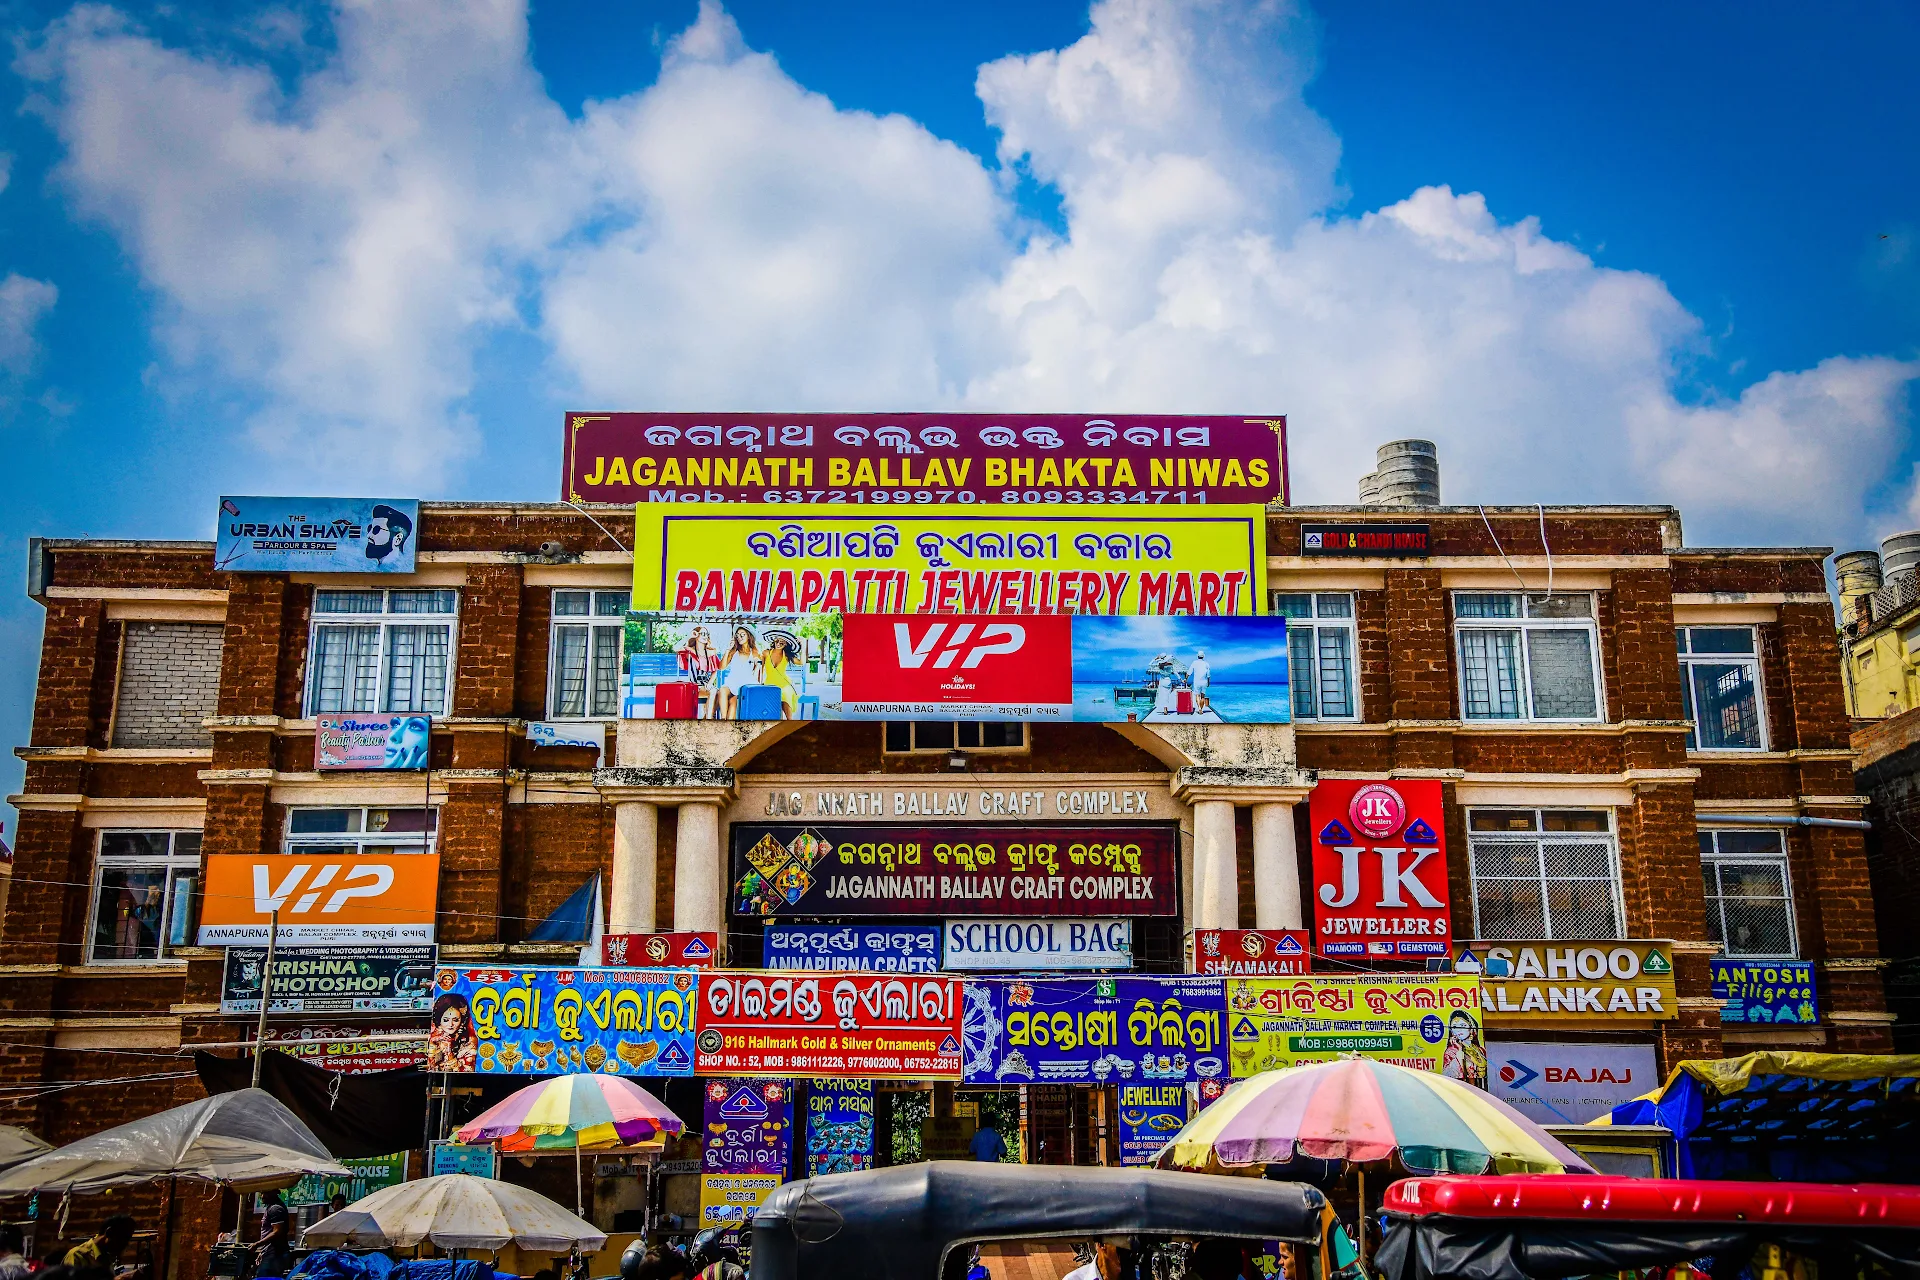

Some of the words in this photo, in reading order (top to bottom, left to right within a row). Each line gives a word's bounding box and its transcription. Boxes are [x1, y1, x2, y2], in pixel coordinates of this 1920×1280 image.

[644, 425, 814, 452] ଜଗନ୍ନାଥ
[834, 426, 960, 453] ବଲ୍ଲଭ
[979, 426, 1065, 449] ଭକ୍ତ
[1083, 419, 1211, 448] ନିବାସ
[584, 457, 814, 487] JAGANNATH
[829, 457, 972, 487] BALLAV
[985, 458, 1137, 487] BHAKTA
[1150, 458, 1270, 488] NIWAS
[763, 491, 987, 504] 6372199970,
[1001, 491, 1207, 504] 8093334711
[230, 522, 295, 540] URBAN
[299, 523, 362, 539] SHAVE
[1323, 532, 1348, 548] GOLD
[1349, 532, 1357, 548] &
[1357, 533, 1392, 548] CHANDI
[1394, 533, 1427, 549] HOUSE
[916, 532, 1058, 567] ଜୁଏଲାରୀ
[1073, 533, 1173, 560] ବଜାର
[674, 569, 910, 612] BANIAPATTI
[917, 570, 1133, 615] JEWELLERY
[1138, 570, 1248, 616] MART
[893, 623, 1026, 669] VIP
[853, 704, 912, 714] ANNAPURNA
[914, 705, 934, 714] BAG
[340, 720, 389, 732] Shree
[320, 732, 350, 752] Beauty
[352, 732, 386, 750] Parlour
[894, 792, 969, 815] BALLAV
[979, 791, 1046, 815] CRAFT
[1056, 791, 1150, 815] COMPLEX
[1362, 798, 1392, 816] JK
[838, 843, 921, 871] ଜଗନ୍ନାଥ
[934, 843, 996, 872] ବଲ୍ଲଭ
[1320, 846, 1446, 908] JK
[252, 864, 394, 914] VIP
[826, 875, 934, 899] JAGANNATH
[940, 876, 1005, 899] BALLAV
[1010, 876, 1065, 900] CRAFT
[1070, 876, 1154, 900] COMPLEX
[206, 928, 269, 938] ANNAPURNA
[1321, 917, 1447, 935] JEWELLERS
[951, 923, 1060, 953] SCHOOL
[1069, 924, 1124, 952] BAG
[1326, 944, 1364, 952] DIAMOND
[1400, 944, 1444, 952] GEMSTONE
[768, 956, 870, 971] ANNAPURNA
[874, 956, 937, 972] CRAFTS
[1486, 948, 1640, 980] SAHOO
[558, 974, 572, 983] J.M
[584, 972, 604, 983] Mob
[613, 972, 670, 984] 9040686082
[1358, 977, 1392, 985] KRISHNA
[1395, 976, 1440, 984] JEWELLERY
[1364, 987, 1479, 1014] ଜୁଏଲାରୀ
[1726, 983, 1812, 1004] Filigree
[472, 974, 542, 1040] ଦୁର୍ଗା
[553, 986, 696, 1042] ଜୁଏଲାରୀ
[832, 980, 955, 1031] ଜୁଏଲାରୀ
[1007, 1010, 1118, 1051] ସନ୍ତୋଷୀ
[1262, 1022, 1304, 1032] JAGANNATH
[1306, 1021, 1332, 1032] BALLAV
[1333, 1021, 1364, 1032] MARKET
[1364, 1021, 1400, 1033] COMPLEX,
[1401, 1020, 1418, 1030] PURI
[1424, 1025, 1441, 1038] 55
[724, 1036, 746, 1049] 916
[748, 1036, 798, 1050] Hallmark
[801, 1037, 826, 1050] Gold
[829, 1038, 838, 1050] &
[841, 1037, 872, 1050] Silver
[875, 1038, 936, 1052] Ornaments
[1299, 1040, 1320, 1050] MOB
[1336, 1038, 1393, 1049] 9861099451
[698, 1056, 724, 1067] SHOP
[726, 1056, 741, 1068] NO.
[748, 1056, 762, 1069] 52,
[764, 1056, 784, 1068] MOB
[790, 1056, 846, 1070] 9861112226,
[847, 1056, 902, 1070] 9776002000,
[1544, 1068, 1632, 1084] BAJAJ
[1121, 1086, 1182, 1106] JEWELLERY
[726, 1124, 763, 1146] ଦୁର୍ଗା
[706, 1149, 778, 1167] ଜୁଏଲାରୀ
[1402, 1182, 1420, 1204] ATUL
